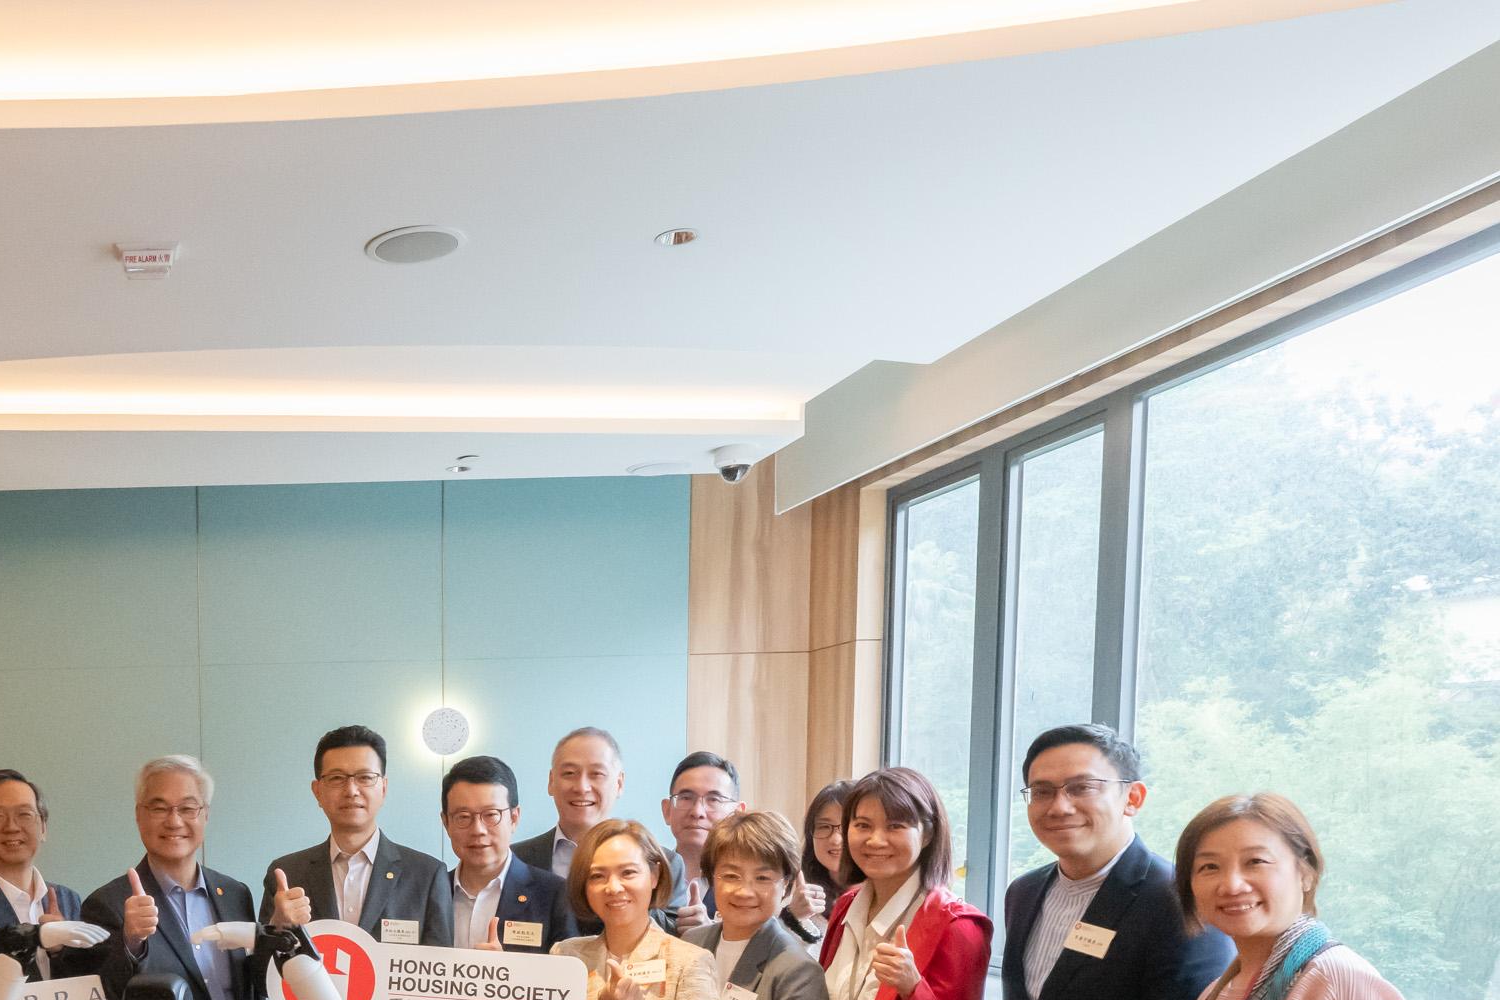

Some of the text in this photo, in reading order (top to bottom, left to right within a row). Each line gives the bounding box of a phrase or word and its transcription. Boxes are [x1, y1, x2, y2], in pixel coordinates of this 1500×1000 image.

[389, 958, 510, 982] HONG KONG
[388, 976, 478, 997] HOUSING
